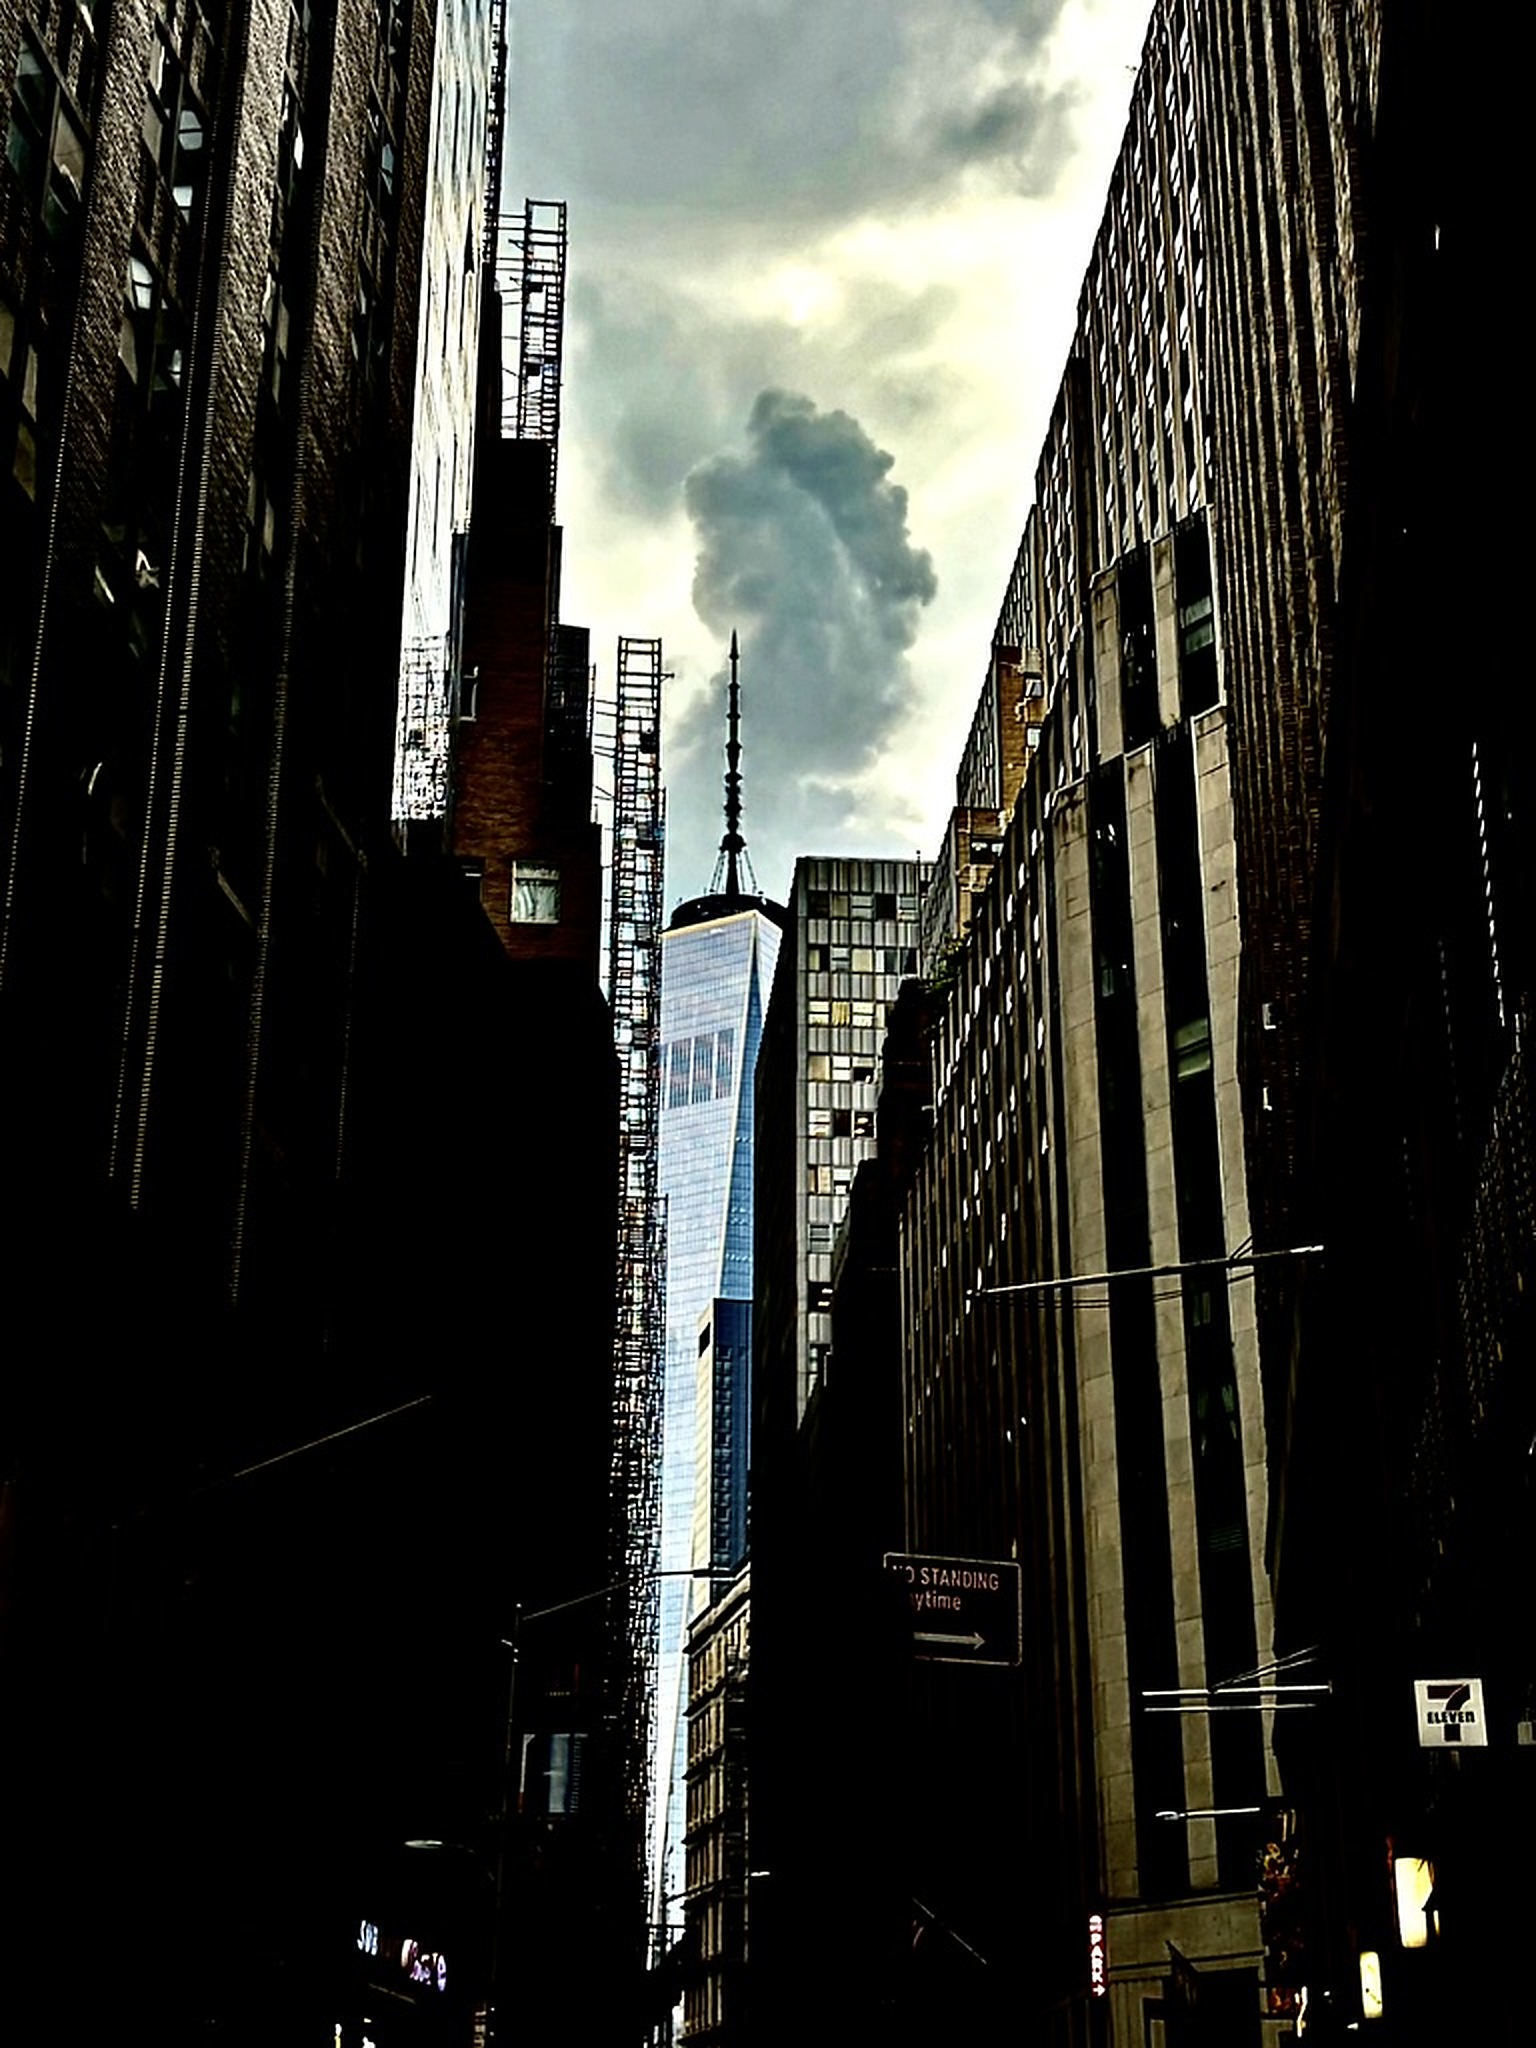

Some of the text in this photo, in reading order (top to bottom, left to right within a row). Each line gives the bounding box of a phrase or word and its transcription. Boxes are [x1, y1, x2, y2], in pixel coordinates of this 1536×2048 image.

[892, 1564, 1000, 1592] O STANDING
[909, 1589, 962, 1612] ytime
[1427, 1684, 1471, 1742] 7
[1090, 1932, 1104, 1983] PARK
